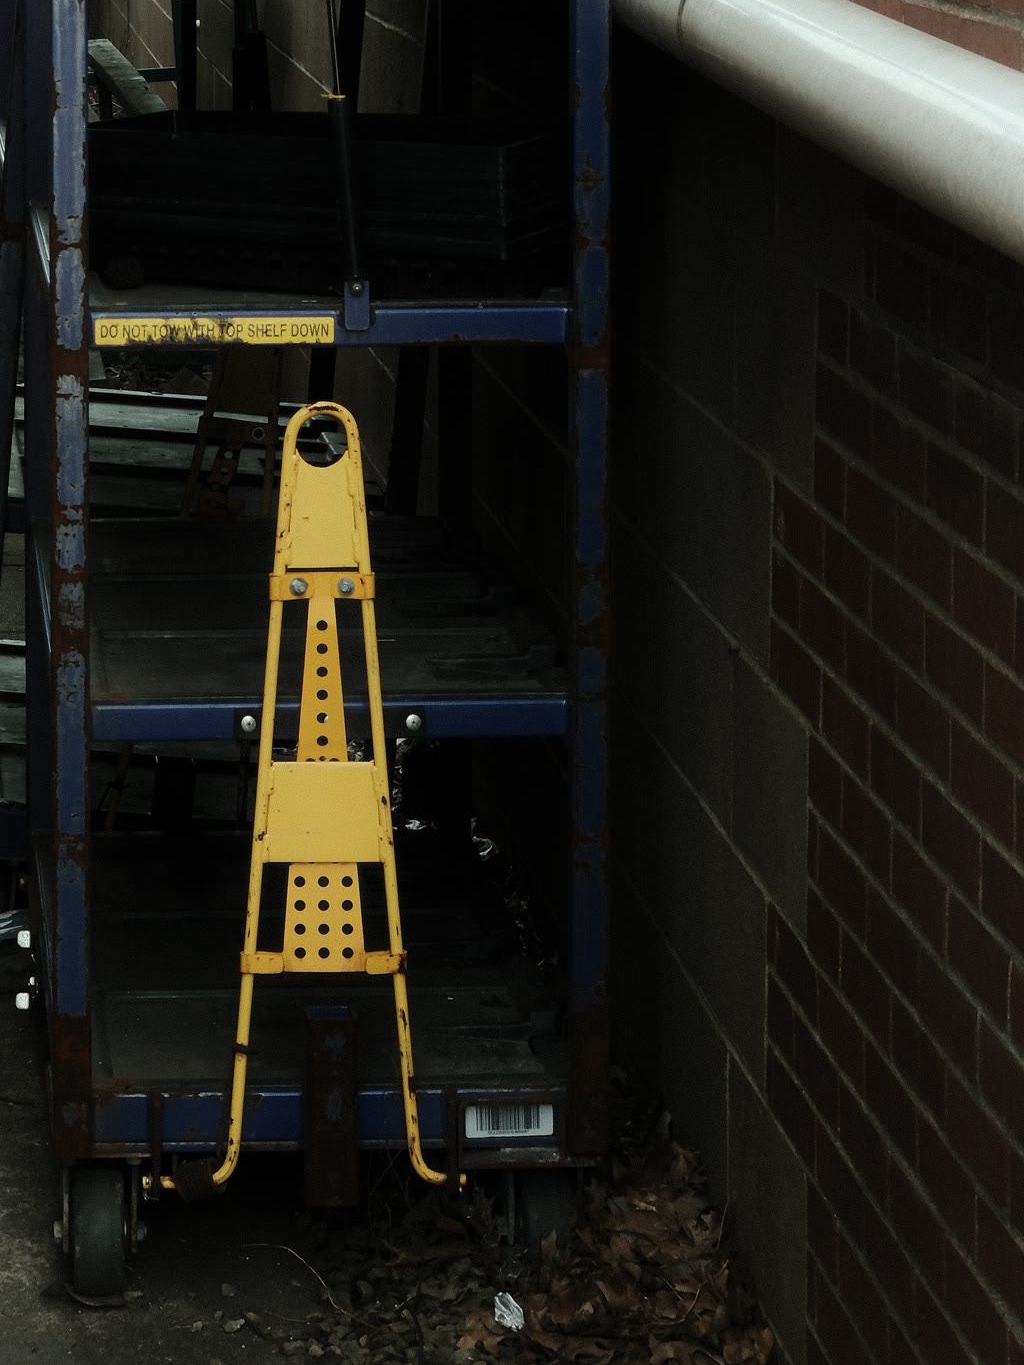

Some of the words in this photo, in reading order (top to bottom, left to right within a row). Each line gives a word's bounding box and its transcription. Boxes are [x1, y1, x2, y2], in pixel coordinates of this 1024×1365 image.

[100, 324, 118, 339] DO
[122, 324, 148, 338] NOT
[152, 324, 178, 338] TOW
[183, 324, 215, 338] WITH
[219, 324, 244, 337] TOP
[247, 323, 287, 337] SHELF
[291, 323, 329, 337] DOWN
